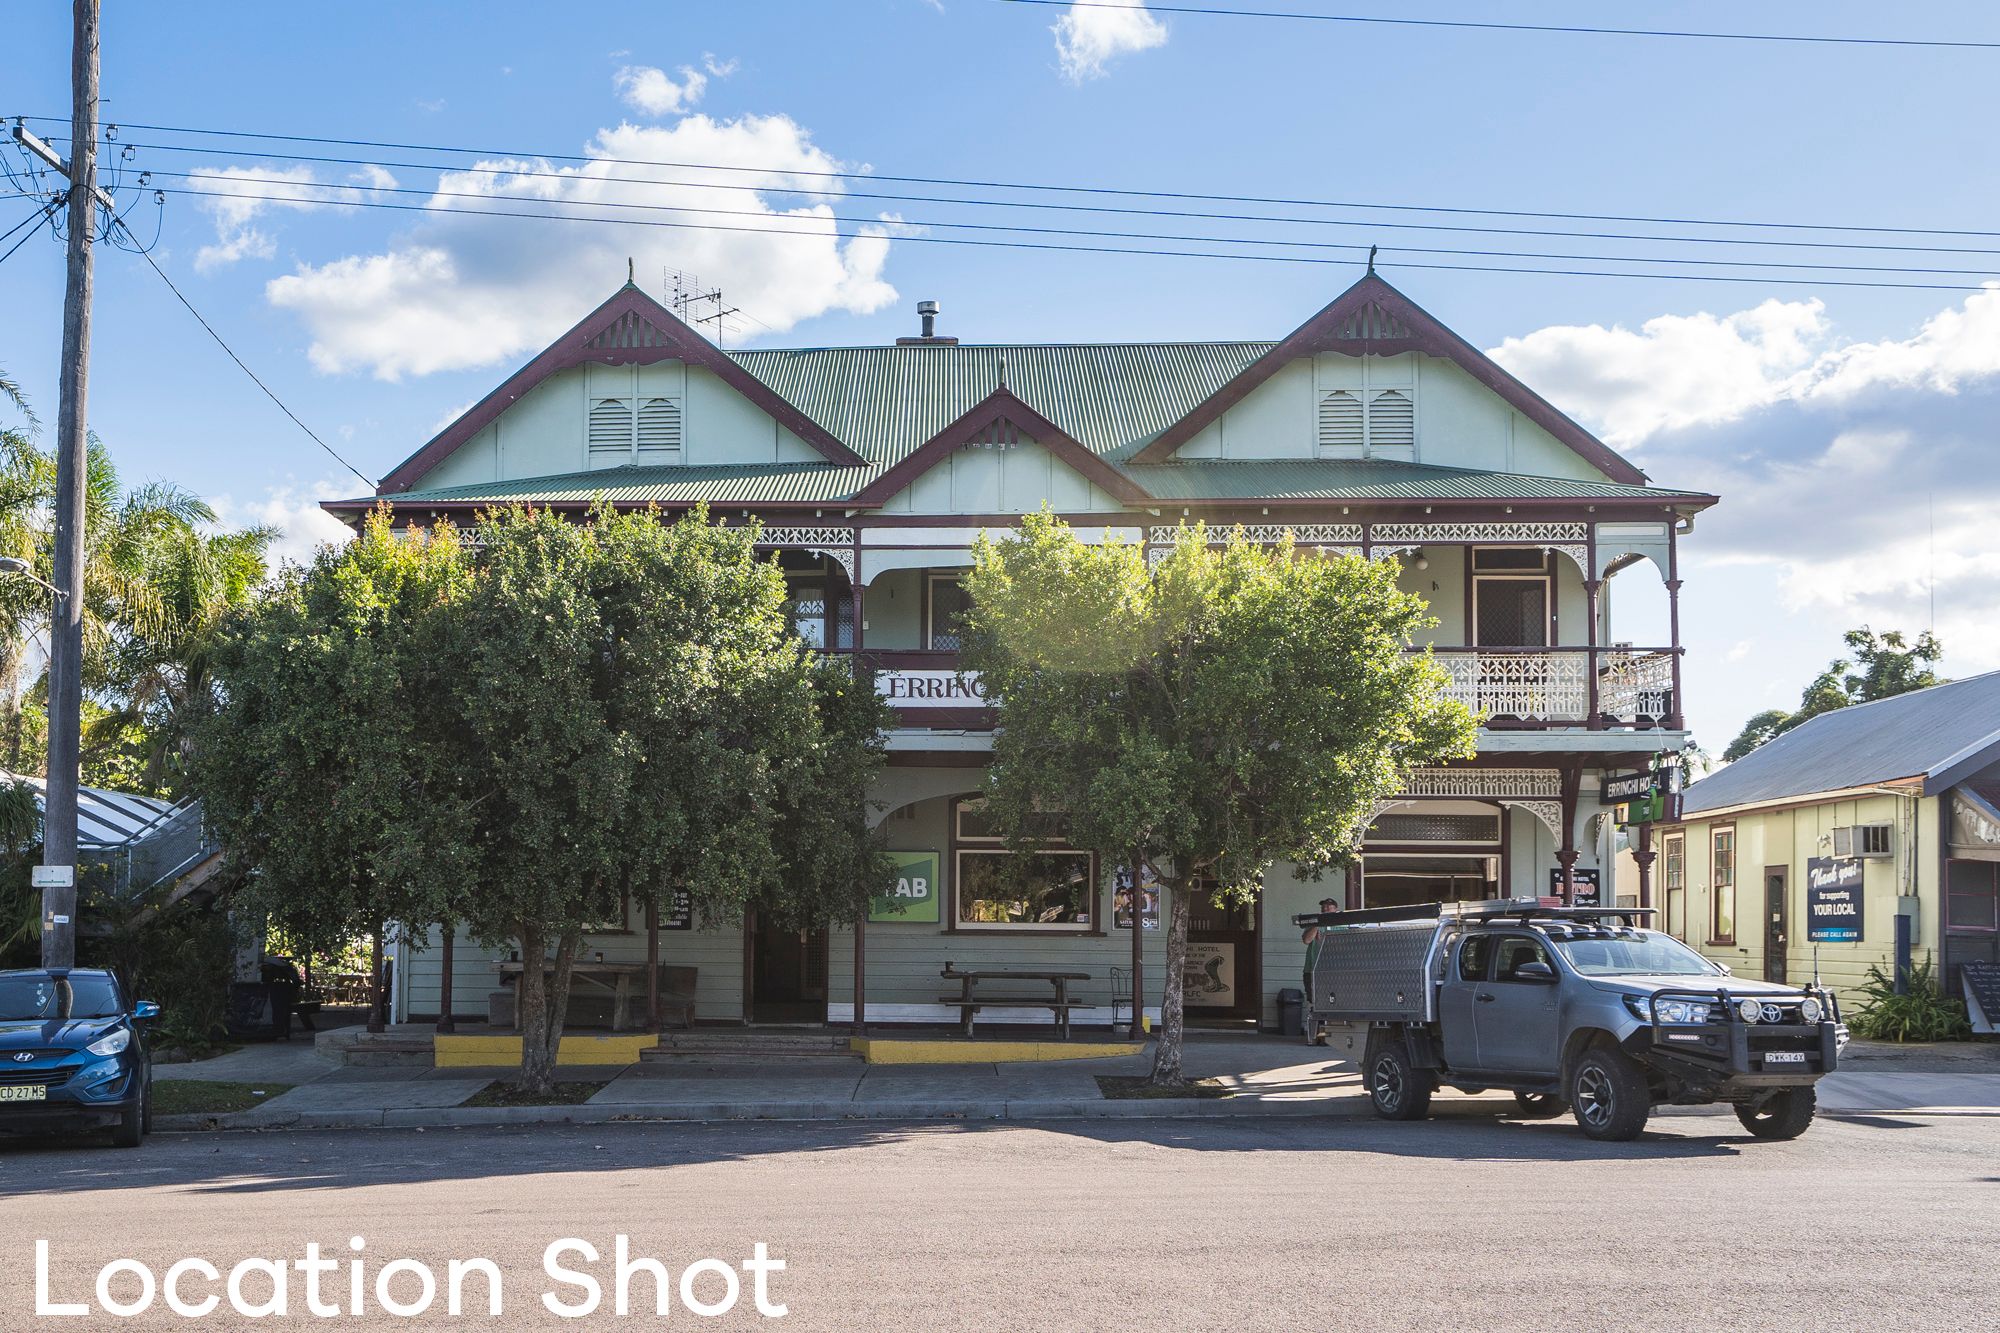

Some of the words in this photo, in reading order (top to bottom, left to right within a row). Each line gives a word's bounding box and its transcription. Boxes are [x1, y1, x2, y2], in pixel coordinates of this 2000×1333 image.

[1607, 778, 1639, 798] ERRINGHI
[1640, 773, 1662, 793] HOL
[1810, 863, 1838, 889] Thank
[1838, 862, 1857, 885] you!
[885, 877, 928, 898] AB
[1827, 891, 1850, 901] supporting
[1813, 904, 1833, 916] YOUR
[1833, 903, 1857, 915] LOCAL
[16, 1087, 30, 1099] 27
[31, 1086, 46, 1098] MS
